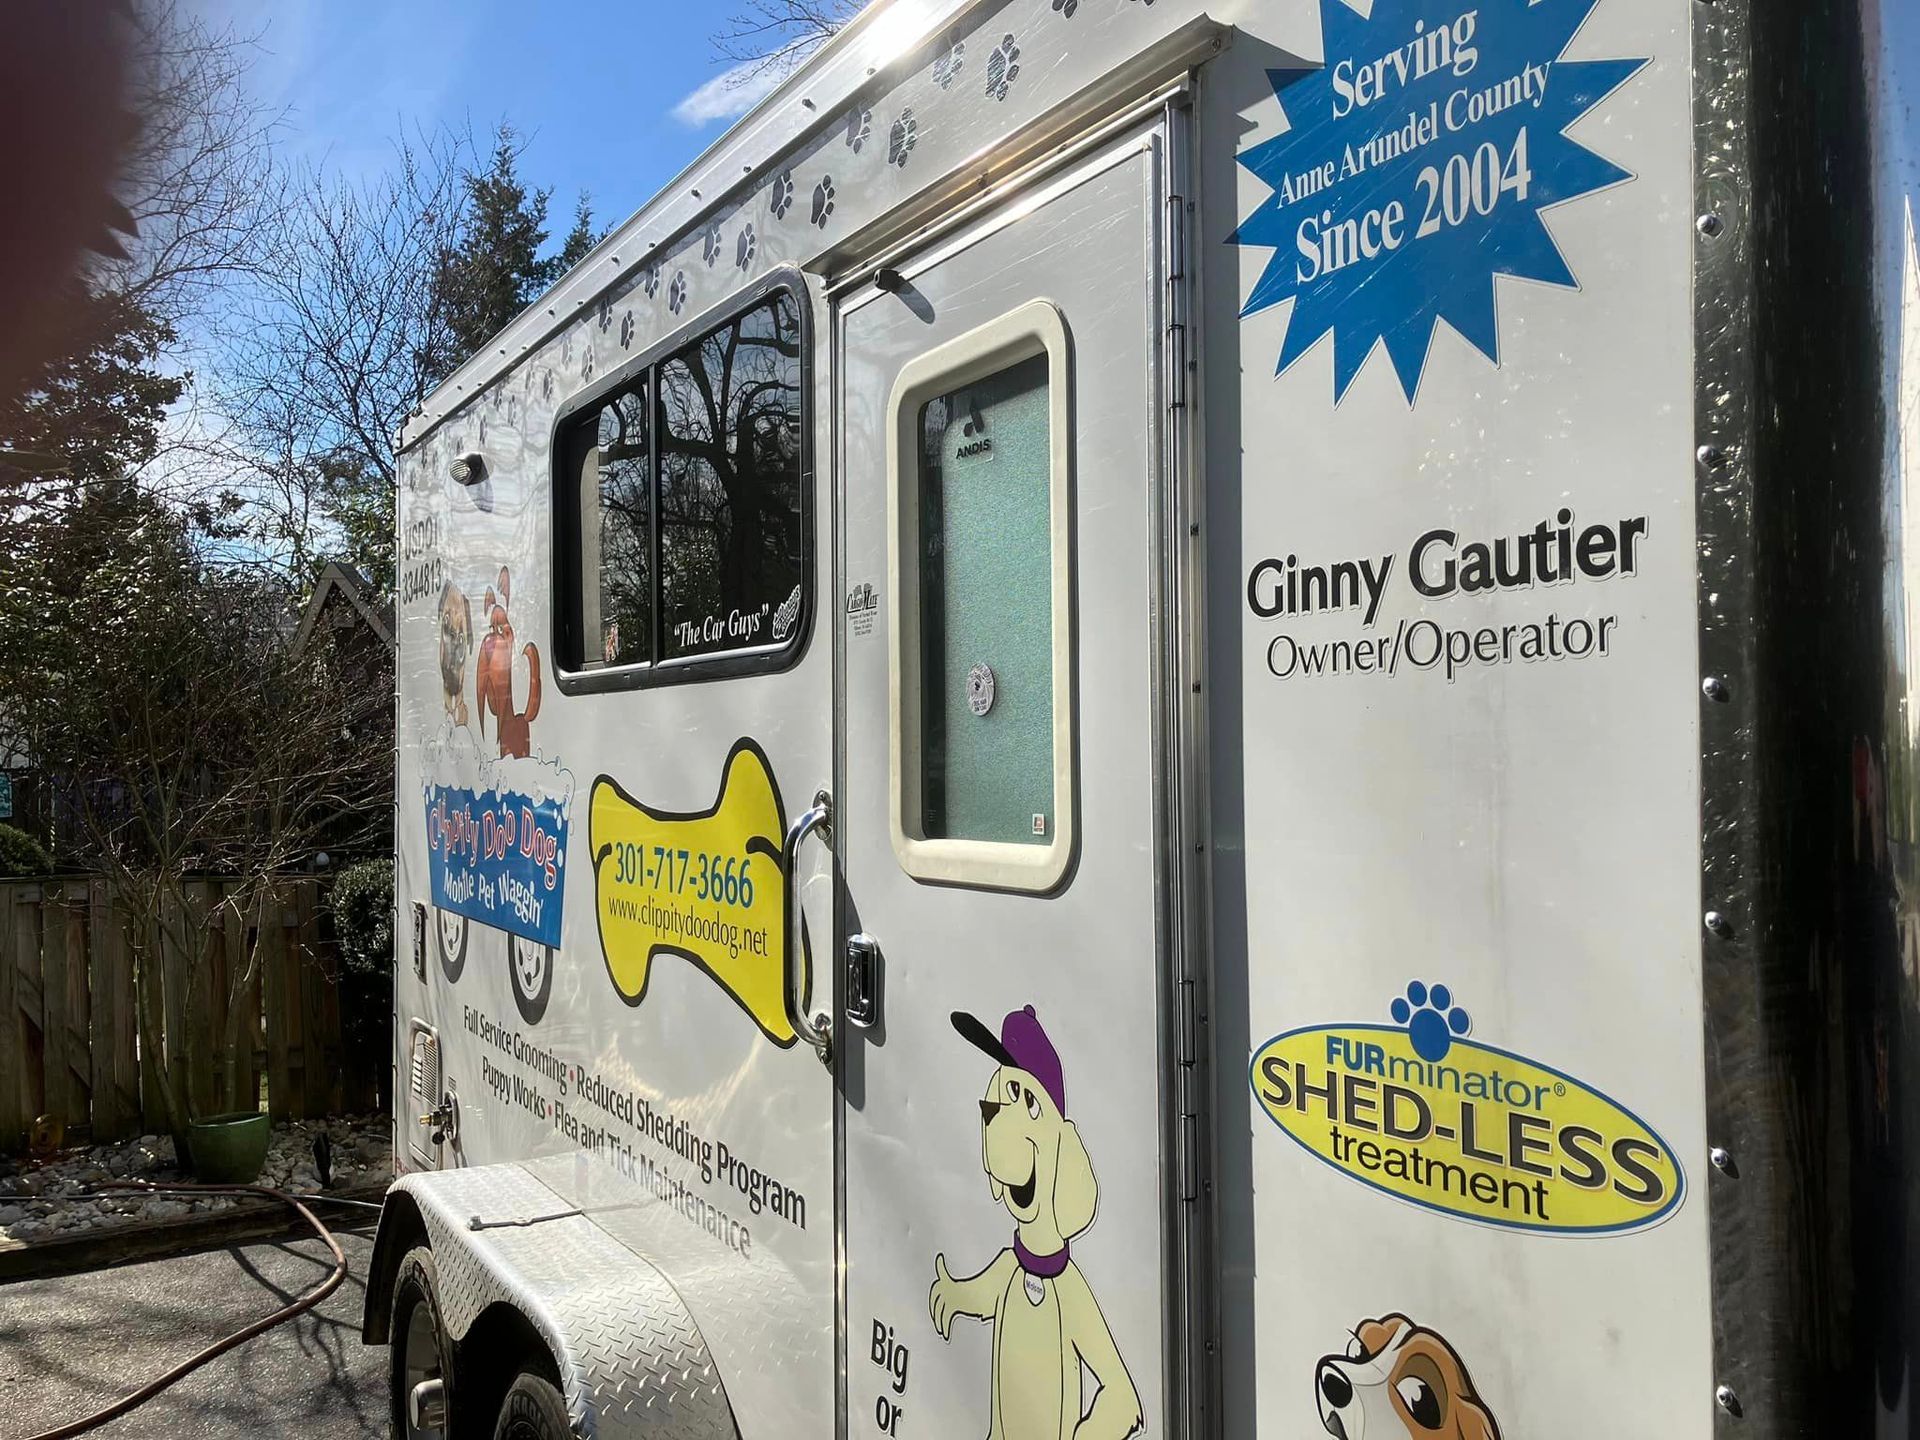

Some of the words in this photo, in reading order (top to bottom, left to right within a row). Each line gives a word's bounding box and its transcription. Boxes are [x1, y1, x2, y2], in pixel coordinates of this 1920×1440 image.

[1332, 10, 1478, 121] Serving
[1276, 161, 1335, 209] Anne
[1338, 102, 1438, 182] Arundel
[1444, 60, 1552, 132] County
[1296, 199, 1405, 285] Since
[1414, 126, 1533, 239] 2004
[956, 439, 991, 459] ANDIS
[404, 515, 438, 561] USDOT
[1248, 552, 1394, 626] Ginny
[1408, 507, 1646, 597] Gautier
[402, 557, 442, 605] 3344813
[703, 615, 725, 642] Car
[1266, 614, 1616, 681] Owner/Operator
[482, 809, 516, 862] Doo
[520, 804, 557, 891] Dog
[614, 841, 754, 909] 301-717-3666
[443, 866, 474, 905] Mobile
[478, 872, 495, 910] Pet
[608, 896, 769, 960] www.clippitydoodog.net
[464, 1004, 479, 1034] Full
[479, 1013, 512, 1056] Service
[513, 1032, 567, 1096] Grooming
[577, 1063, 633, 1126] Reduced
[636, 1100, 713, 1184] Shedding
[716, 1140, 807, 1231] Program
[1260, 1055, 1666, 1204] SHED-LESS
[482, 1056, 512, 1107] Puppy
[513, 1078, 546, 1120] Works
[554, 1100, 578, 1138] Flea
[581, 1120, 605, 1160] and
[607, 1131, 637, 1184] Tick
[640, 1153, 752, 1260] Maintenance
[1330, 1126, 1550, 1220] treatment
[871, 1317, 909, 1394] Big
[876, 1395, 903, 1438] or
